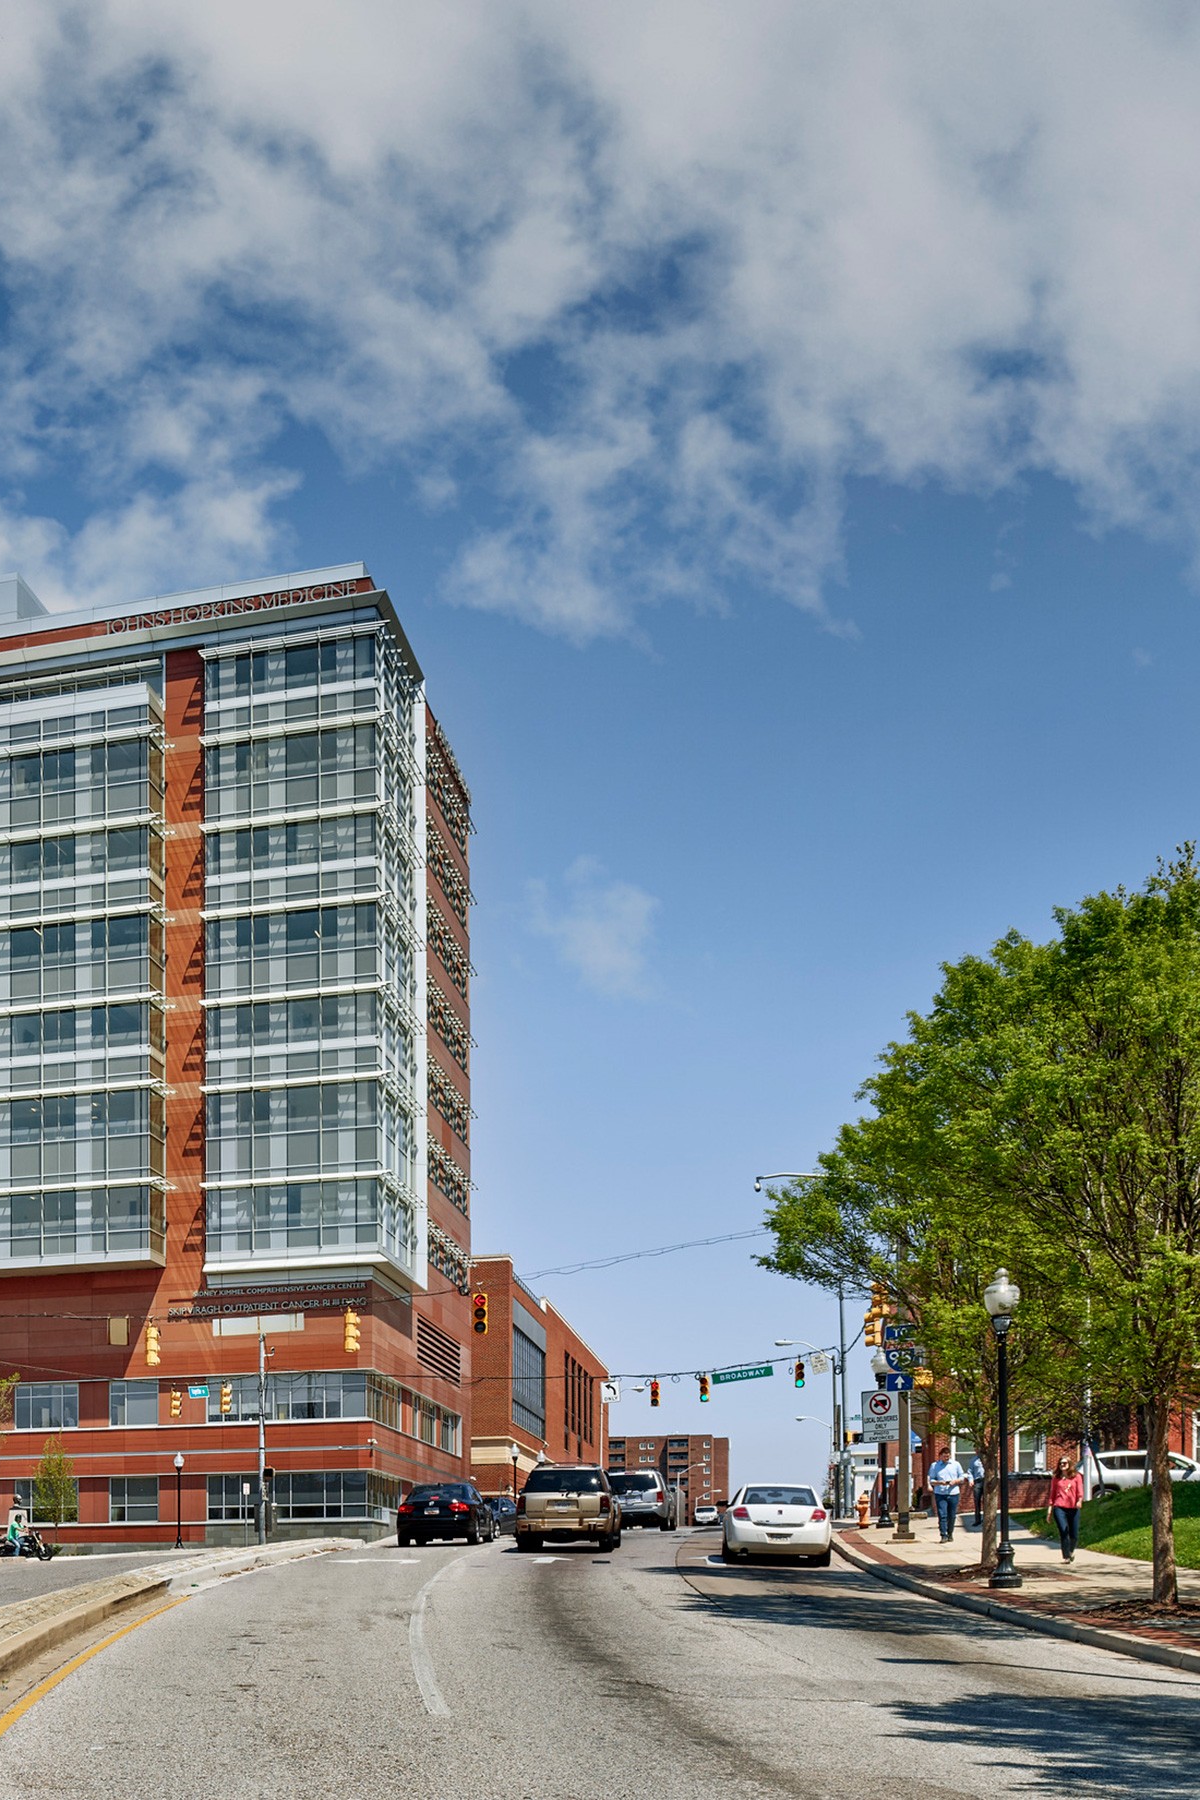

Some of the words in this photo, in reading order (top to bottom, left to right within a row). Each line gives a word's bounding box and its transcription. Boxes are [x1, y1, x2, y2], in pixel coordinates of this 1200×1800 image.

[105, 611, 166, 635] JOHNS
[168, 597, 255, 625] HOPKINS
[259, 580, 358, 611] MEDICINE
[193, 1289, 218, 1297] SIDNEY
[219, 1288, 245, 1296] KIMMEL
[246, 1284, 305, 1295] COMPREHENSIVE
[306, 1283, 336, 1291] CANCER
[337, 1282, 366, 1290] CENTER
[168, 1307, 187, 1316] SKIP
[187, 1305, 221, 1315] VIRAGH
[223, 1302, 279, 1313] OUTPATIENT
[281, 1300, 320, 1310] CANCER
[889, 1351, 912, 1366] 95
[720, 1369, 765, 1381] BROADWAY
